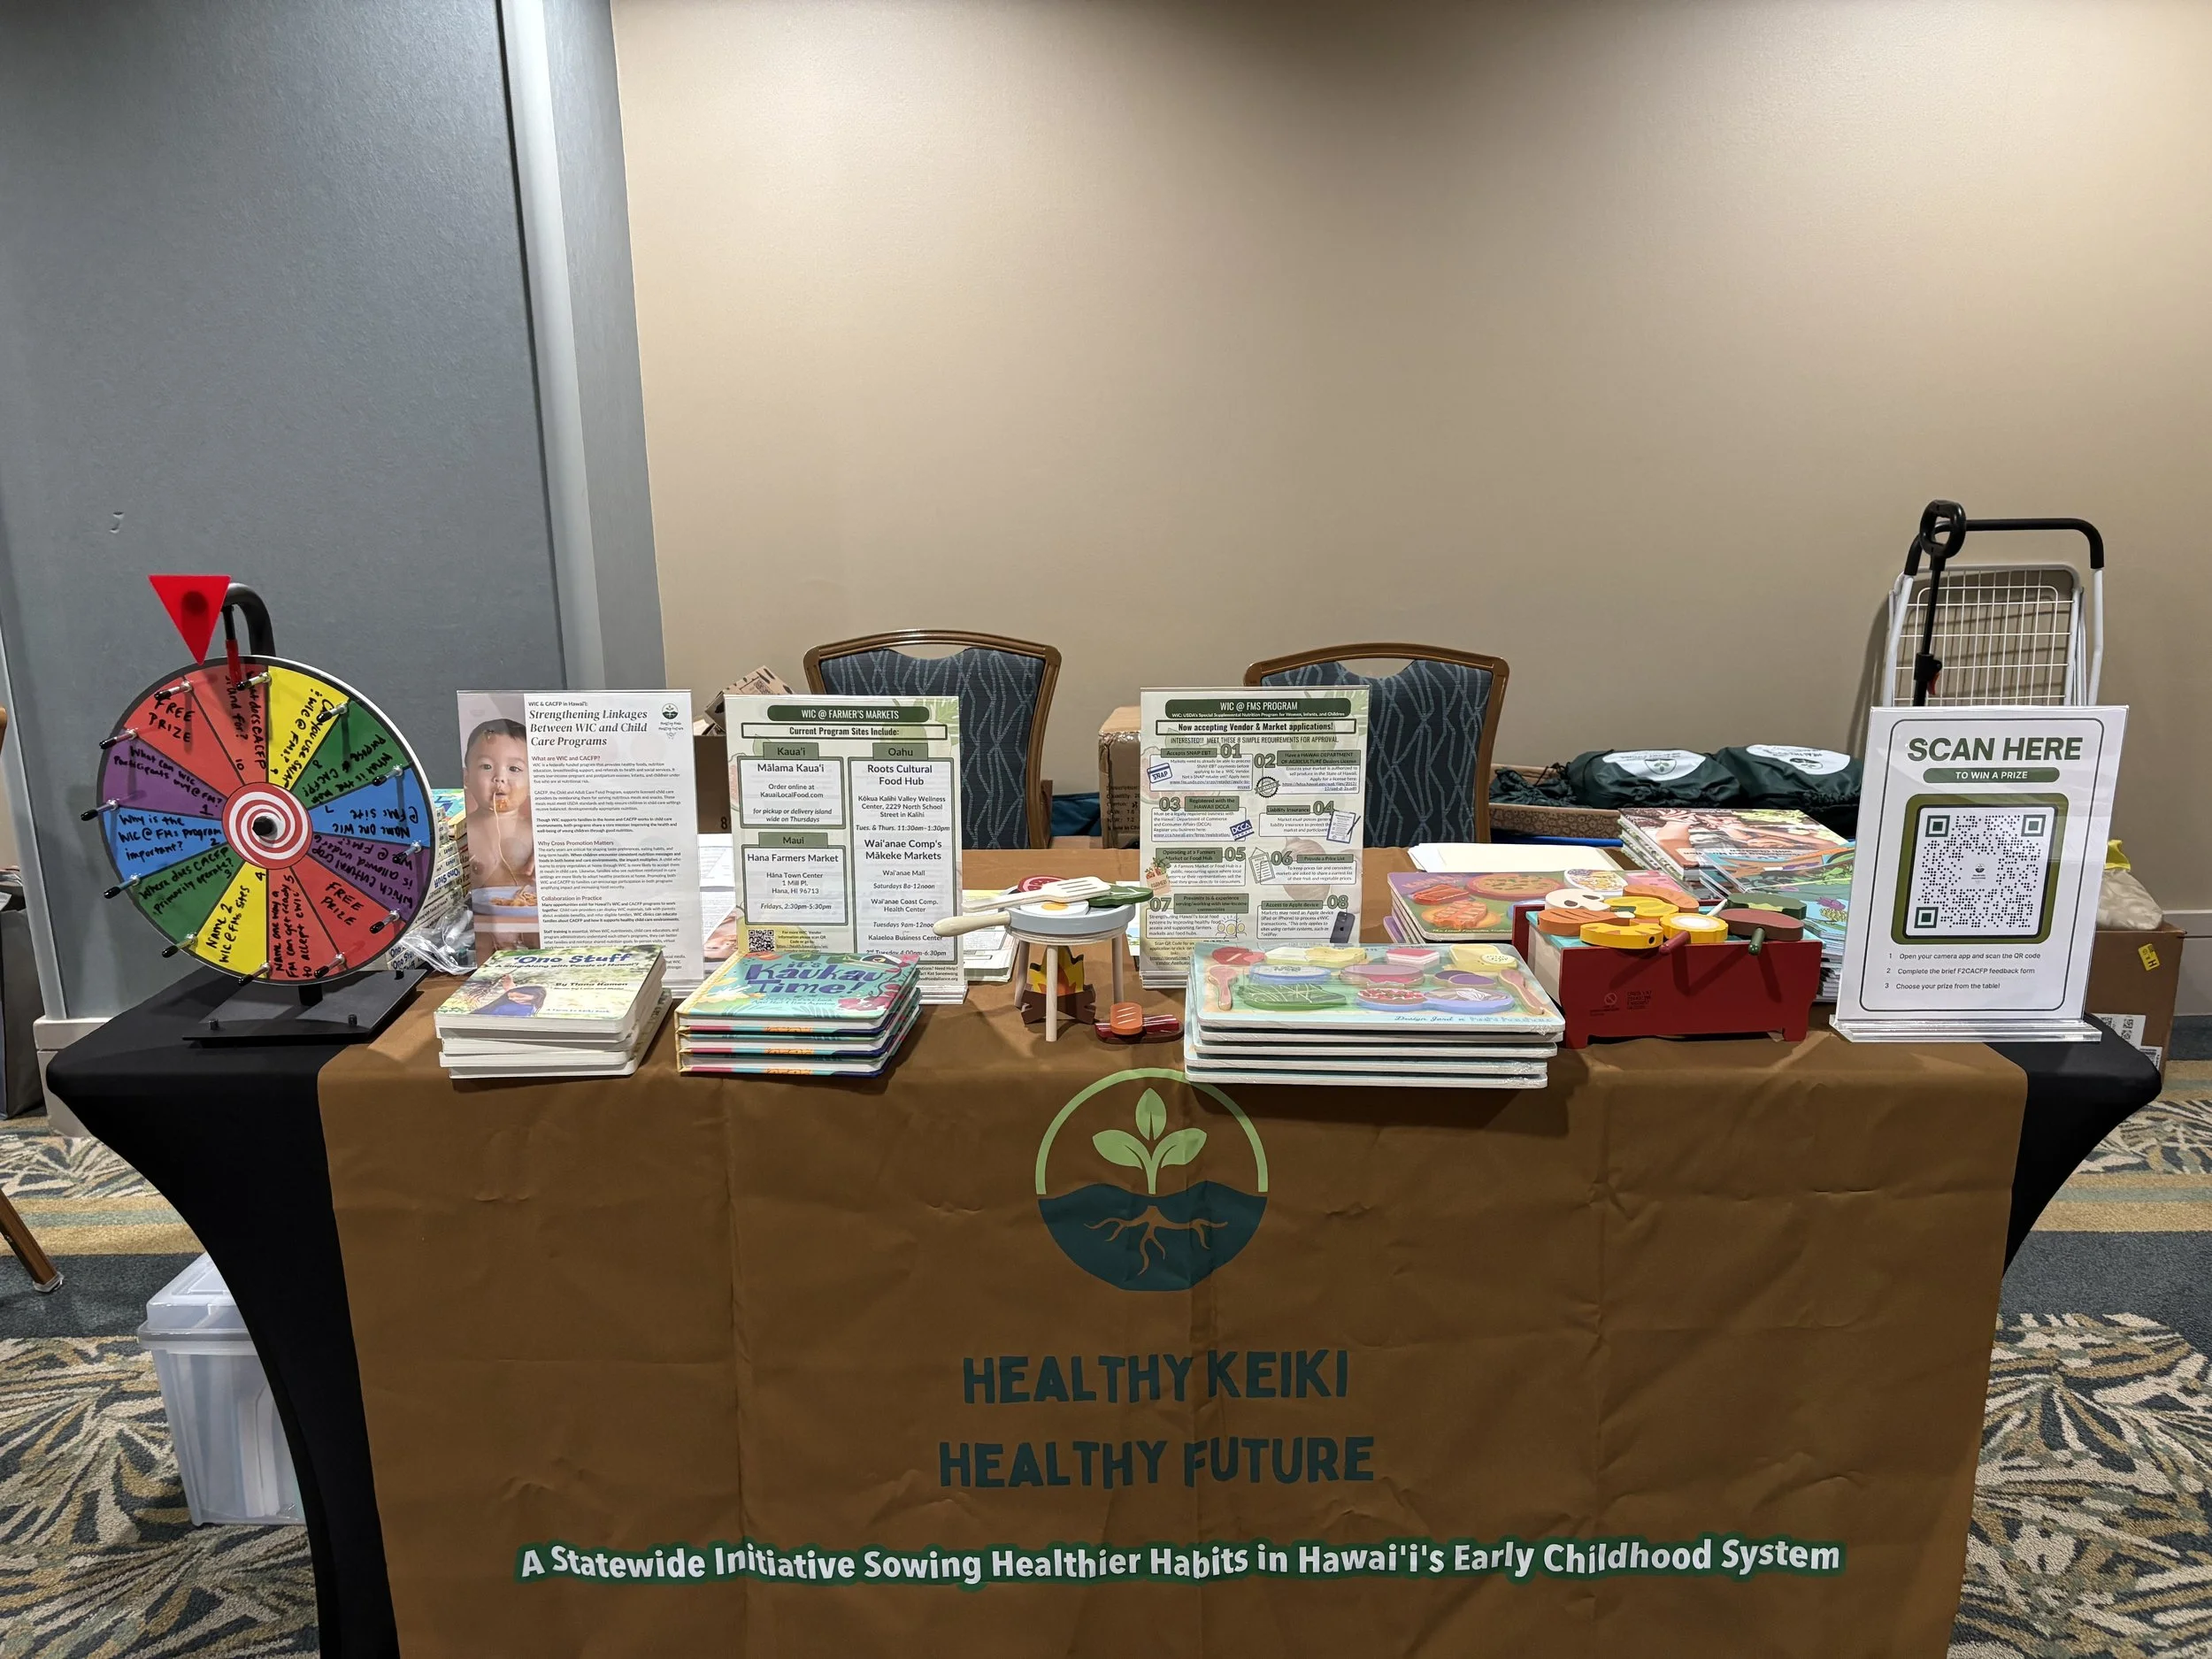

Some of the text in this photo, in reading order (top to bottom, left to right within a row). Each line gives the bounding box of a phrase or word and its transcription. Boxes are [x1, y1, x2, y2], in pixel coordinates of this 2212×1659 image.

[154, 698, 196, 722] FREE
[1220, 702, 1234, 710] WIC
[1236, 702, 1244, 711] @
[1263, 702, 1297, 710] PROGRAM
[530, 710, 647, 721] Strengthening Linkages
[802, 710, 899, 719] WIC @ FARMER'S MARKETS
[148, 712, 192, 742] PRIZE
[576, 724, 596, 732] WIC
[599, 723, 618, 732] and
[621, 723, 647, 732] Child
[819, 727, 849, 736] Program
[871, 727, 899, 735] Include:
[1289, 722, 1333, 732] applications!
[558, 737, 607, 748] Programs
[1908, 737, 2083, 761] SCAN HERE
[1220, 743, 1242, 758] 01
[1254, 753, 1276, 768] 02
[868, 764, 894, 773] Roots
[1152, 771, 1168, 781] SNAP
[1159, 797, 1181, 811] 03
[1313, 801, 1335, 815] 04
[721, 816, 728, 830] 8
[1231, 822, 1252, 834] DCCA
[118, 831, 141, 843] WIC
[142, 828, 153, 839] @
[183, 829, 222, 840] program
[126, 841, 184, 862] important?
[1225, 847, 1246, 861] 05
[1271, 851, 1293, 866] 06
[325, 882, 365, 911] FREE
[1327, 895, 1349, 909] 08
[321, 896, 357, 926] PRIZE
[1150, 898, 1172, 912] 07
[569, 953, 633, 963] Stuff
[745, 963, 885, 982] Kaukau
[747, 979, 866, 994] Time!
[963, 1349, 1348, 1404] HEALTHY KEIKI
[939, 1435, 1375, 1489] HEALTHY FUTURE
[521, 1538, 1839, 1585] A Statewide Initiative Sowing Healthier Habits in Hawai'i's Early Childhood System
